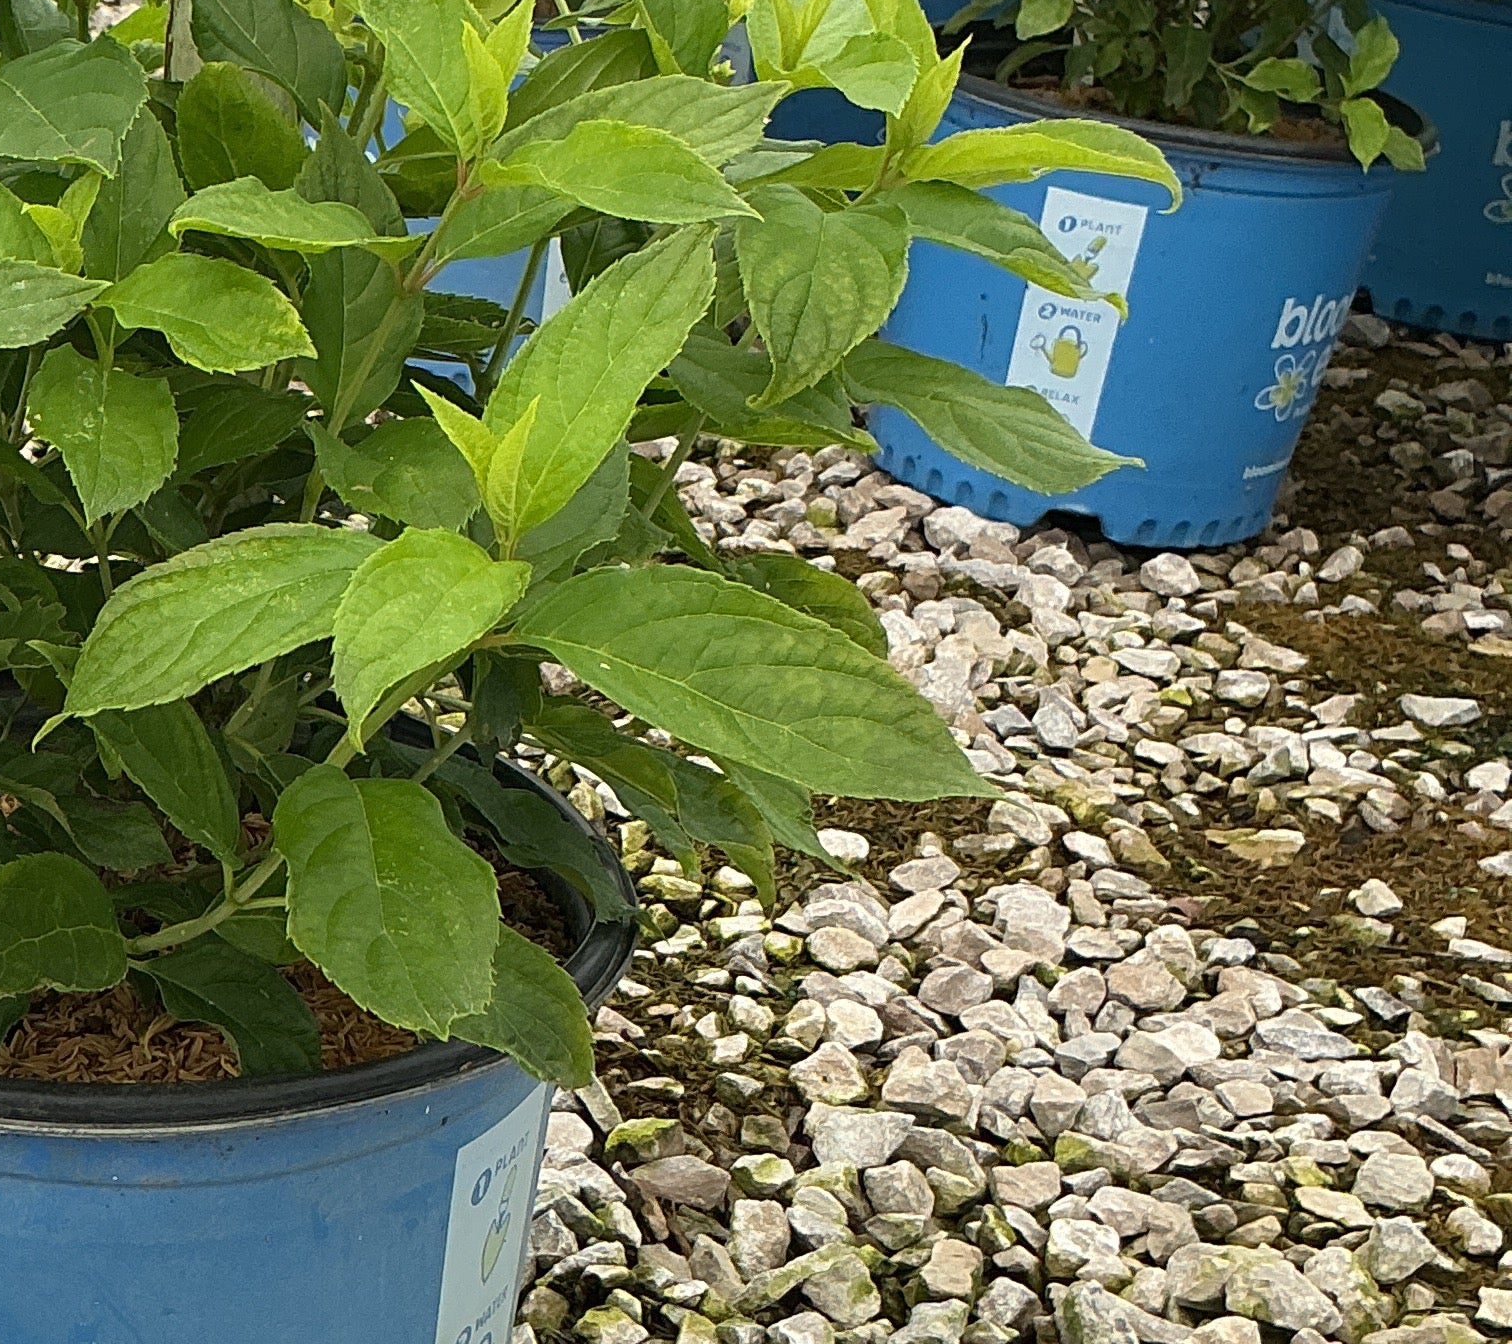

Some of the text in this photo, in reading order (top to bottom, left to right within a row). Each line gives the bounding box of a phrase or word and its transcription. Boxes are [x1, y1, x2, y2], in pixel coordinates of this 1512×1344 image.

[1080, 219, 1123, 236] PLANT
[1060, 307, 1101, 324] WATER
[494, 1131, 531, 1177] PLANT
